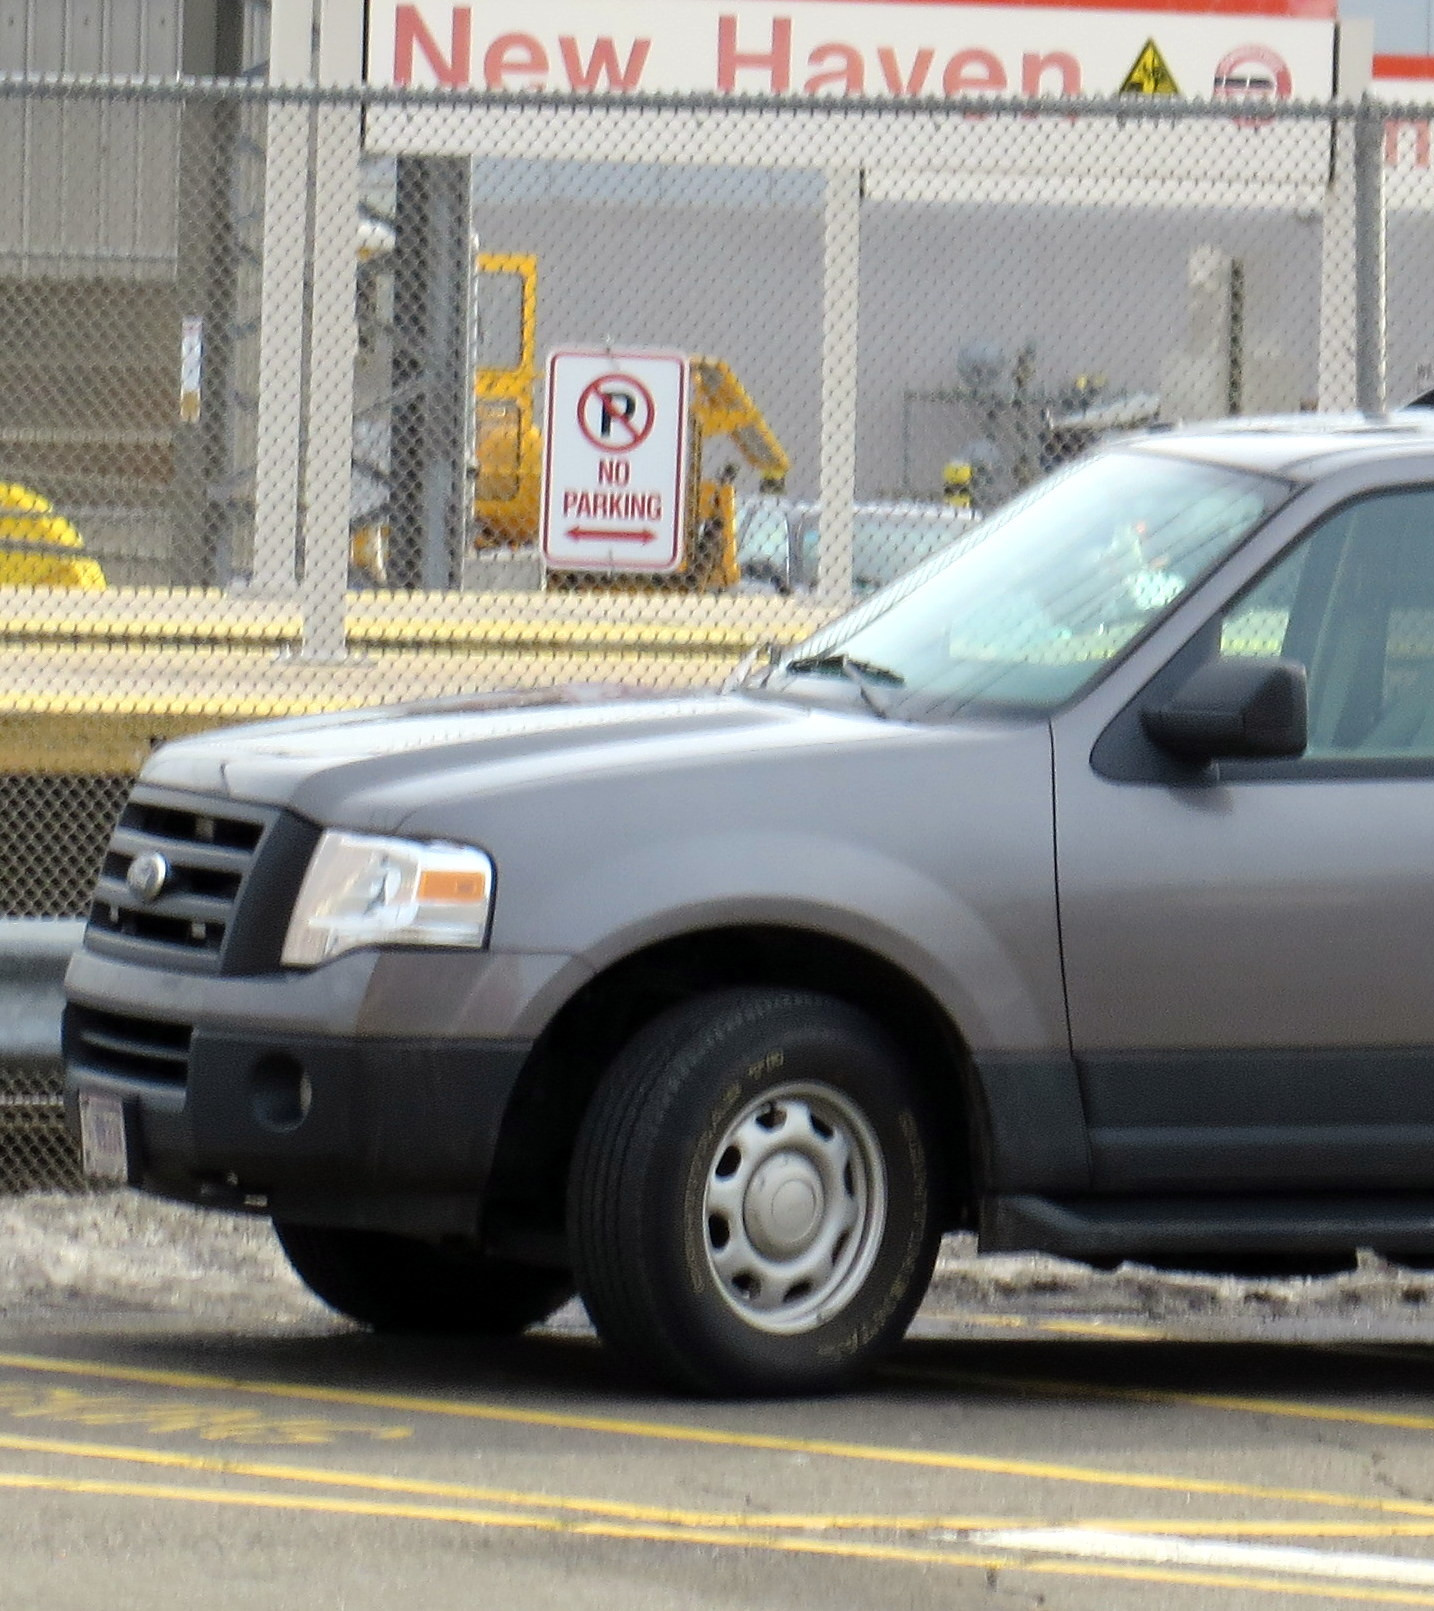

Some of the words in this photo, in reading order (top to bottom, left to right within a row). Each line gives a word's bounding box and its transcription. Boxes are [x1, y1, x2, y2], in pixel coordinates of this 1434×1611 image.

[393, 3, 652, 98] New
[716, 13, 1083, 118] Haven
[598, 459, 630, 485] NO
[563, 491, 662, 521] PARKING
